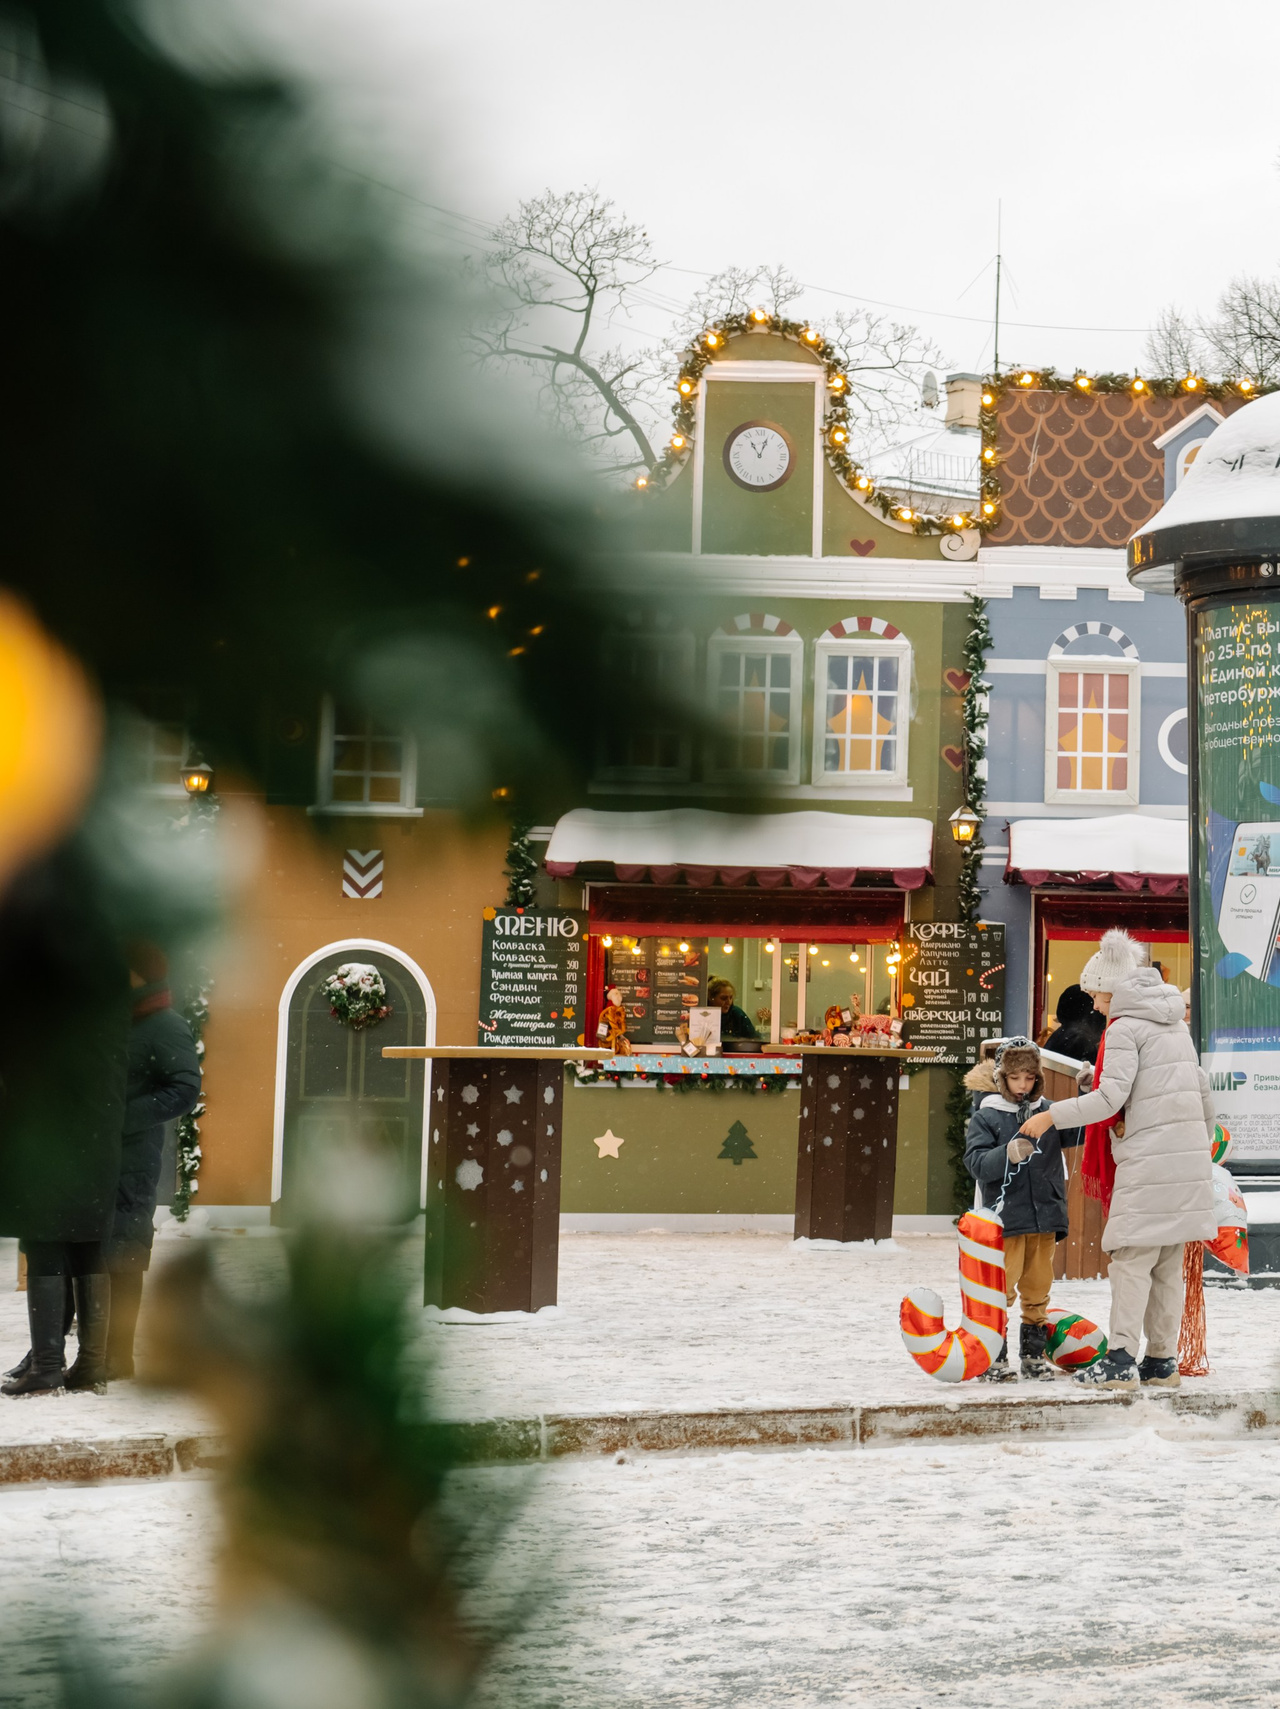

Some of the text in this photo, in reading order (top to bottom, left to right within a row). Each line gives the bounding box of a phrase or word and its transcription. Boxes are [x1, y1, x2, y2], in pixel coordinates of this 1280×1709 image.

[1204, 625, 1237, 642] Плати
[1242, 624, 1252, 636] с
[1204, 651, 1215, 667] до
[1251, 643, 1272, 656] по
[1211, 661, 1266, 684] Единой
[1204, 717, 1250, 735] Выгодные
[494, 915, 579, 938] МЕНЮ
[492, 939, 580, 952] Колбаска 320
[920, 941, 961, 950] Американо
[491, 951, 546, 964] Колбаска
[920, 950, 960, 959] Капучино
[566, 960, 580, 970] 390
[919, 957, 949, 967] Латте
[490, 969, 578, 982] Тушеная капуста 170
[909, 966, 950, 987] ЧАЙ
[490, 981, 578, 994] Сэндвич 270
[489, 992, 578, 1006] Френчдог 270
[967, 992, 977, 1003] 120
[980, 992, 990, 1003] 150
[489, 1009, 542, 1022] Жареный
[903, 1007, 1002, 1024] АВТОРСКИЙ ЧАЙ
[510, 1021, 576, 1032] миндаль 250
[483, 1032, 556, 1046] Рождественский
[1229, 1036, 1265, 1045] действует
[1273, 1035, 1277, 1043] 1
[966, 1046, 977, 1054] 150
[1209, 1071, 1247, 1091] МИР
